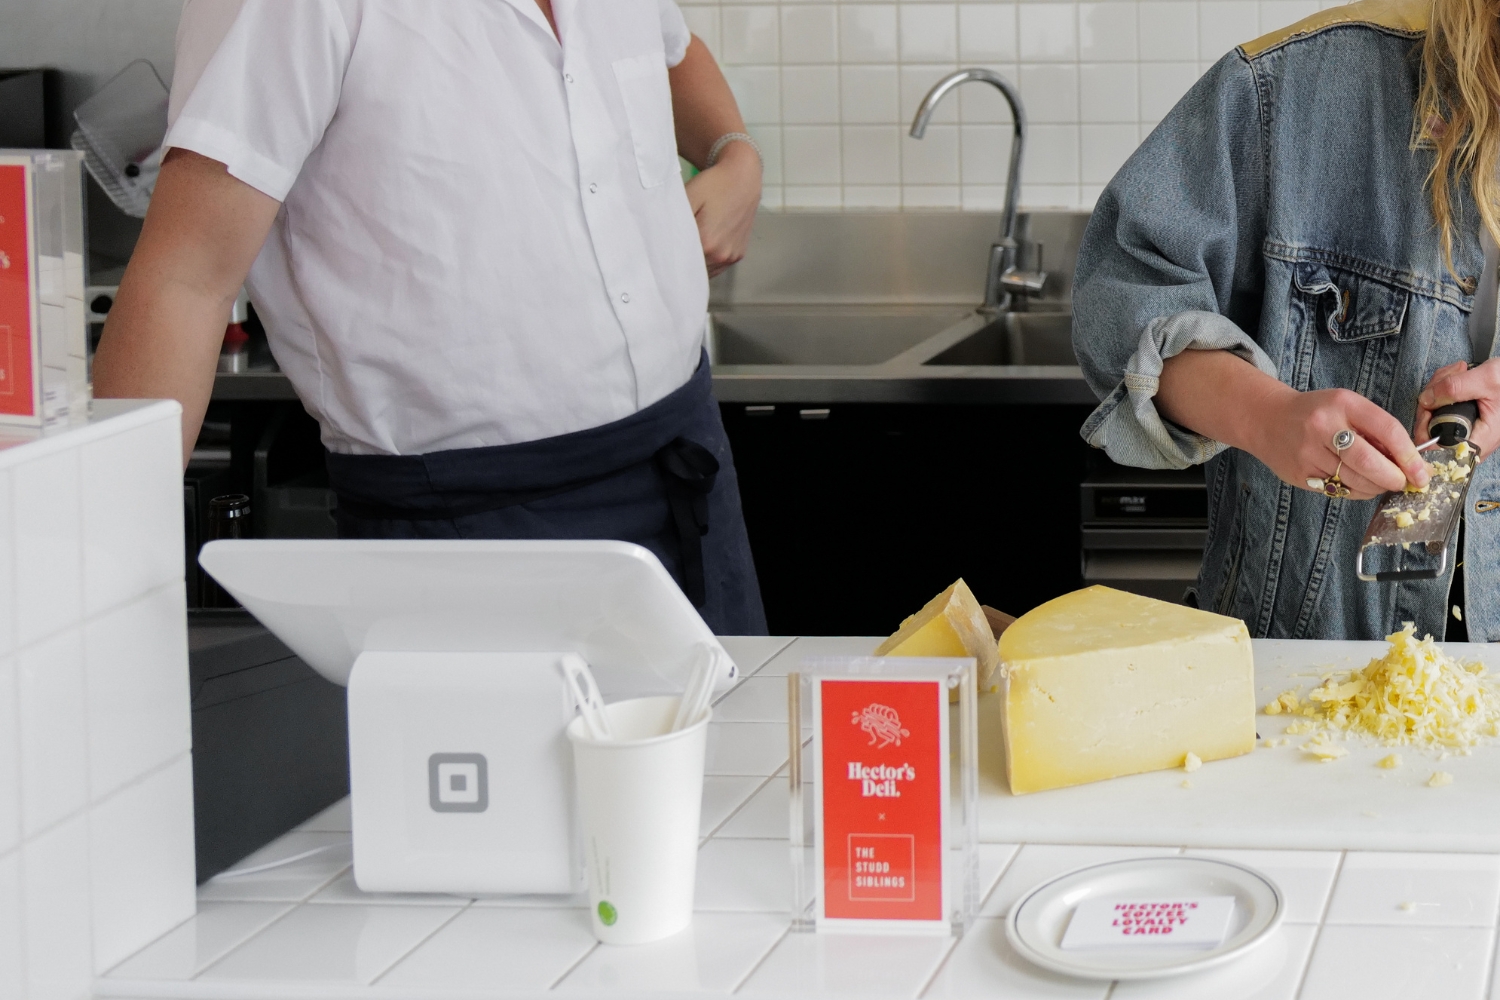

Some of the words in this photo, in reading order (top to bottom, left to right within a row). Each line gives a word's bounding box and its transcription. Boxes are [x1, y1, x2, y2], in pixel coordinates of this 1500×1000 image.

[847, 761, 916, 781] Hector's
[861, 779, 901, 798] Deli.
[855, 847, 875, 859] THE
[855, 861, 890, 874] STUDD
[855, 875, 905, 888] SIBLINGS
[1114, 902, 1199, 910] HECTOR'S
[1121, 910, 1185, 918] COFFEE
[1111, 917, 1189, 926] LOYALTY
[1121, 926, 1173, 935] CARD
